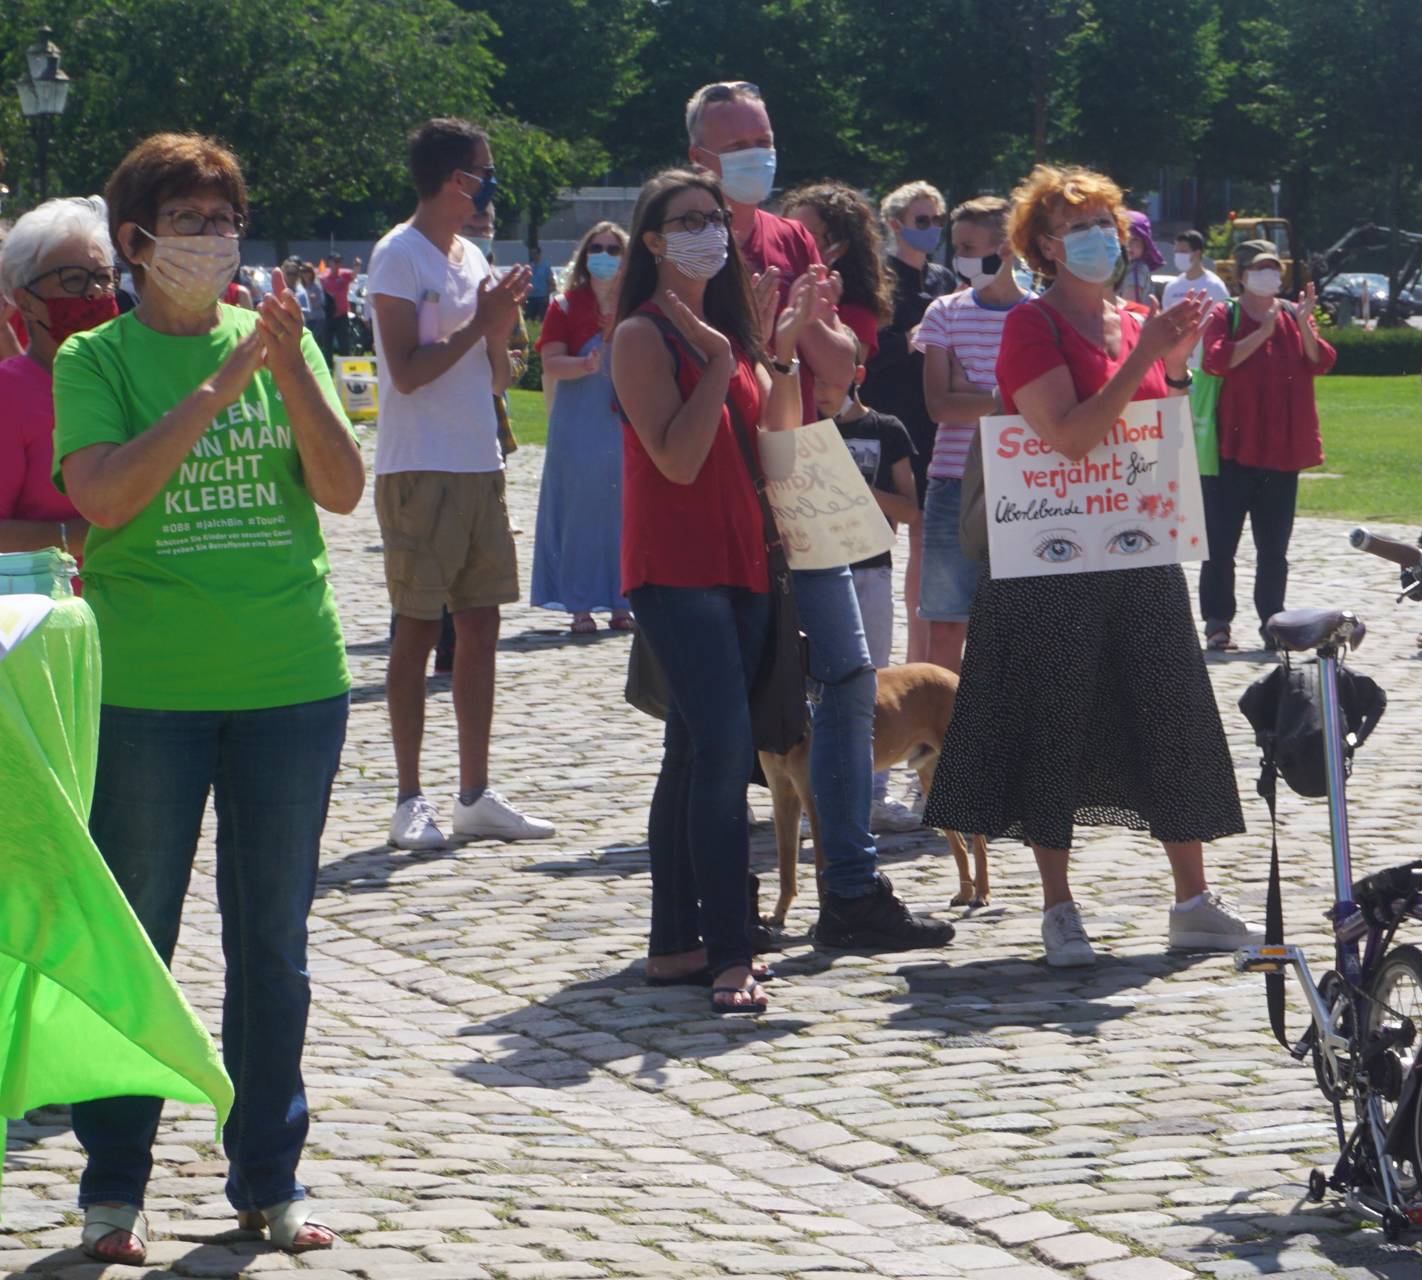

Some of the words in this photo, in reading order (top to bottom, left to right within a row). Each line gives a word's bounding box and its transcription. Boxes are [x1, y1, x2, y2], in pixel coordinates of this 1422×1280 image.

[228, 424, 291, 452] MAN
[179, 454, 264, 486] NICHT
[1022, 452, 1123, 499] verjährt
[1126, 450, 1159, 487] für
[1086, 487, 1129, 516] nie
